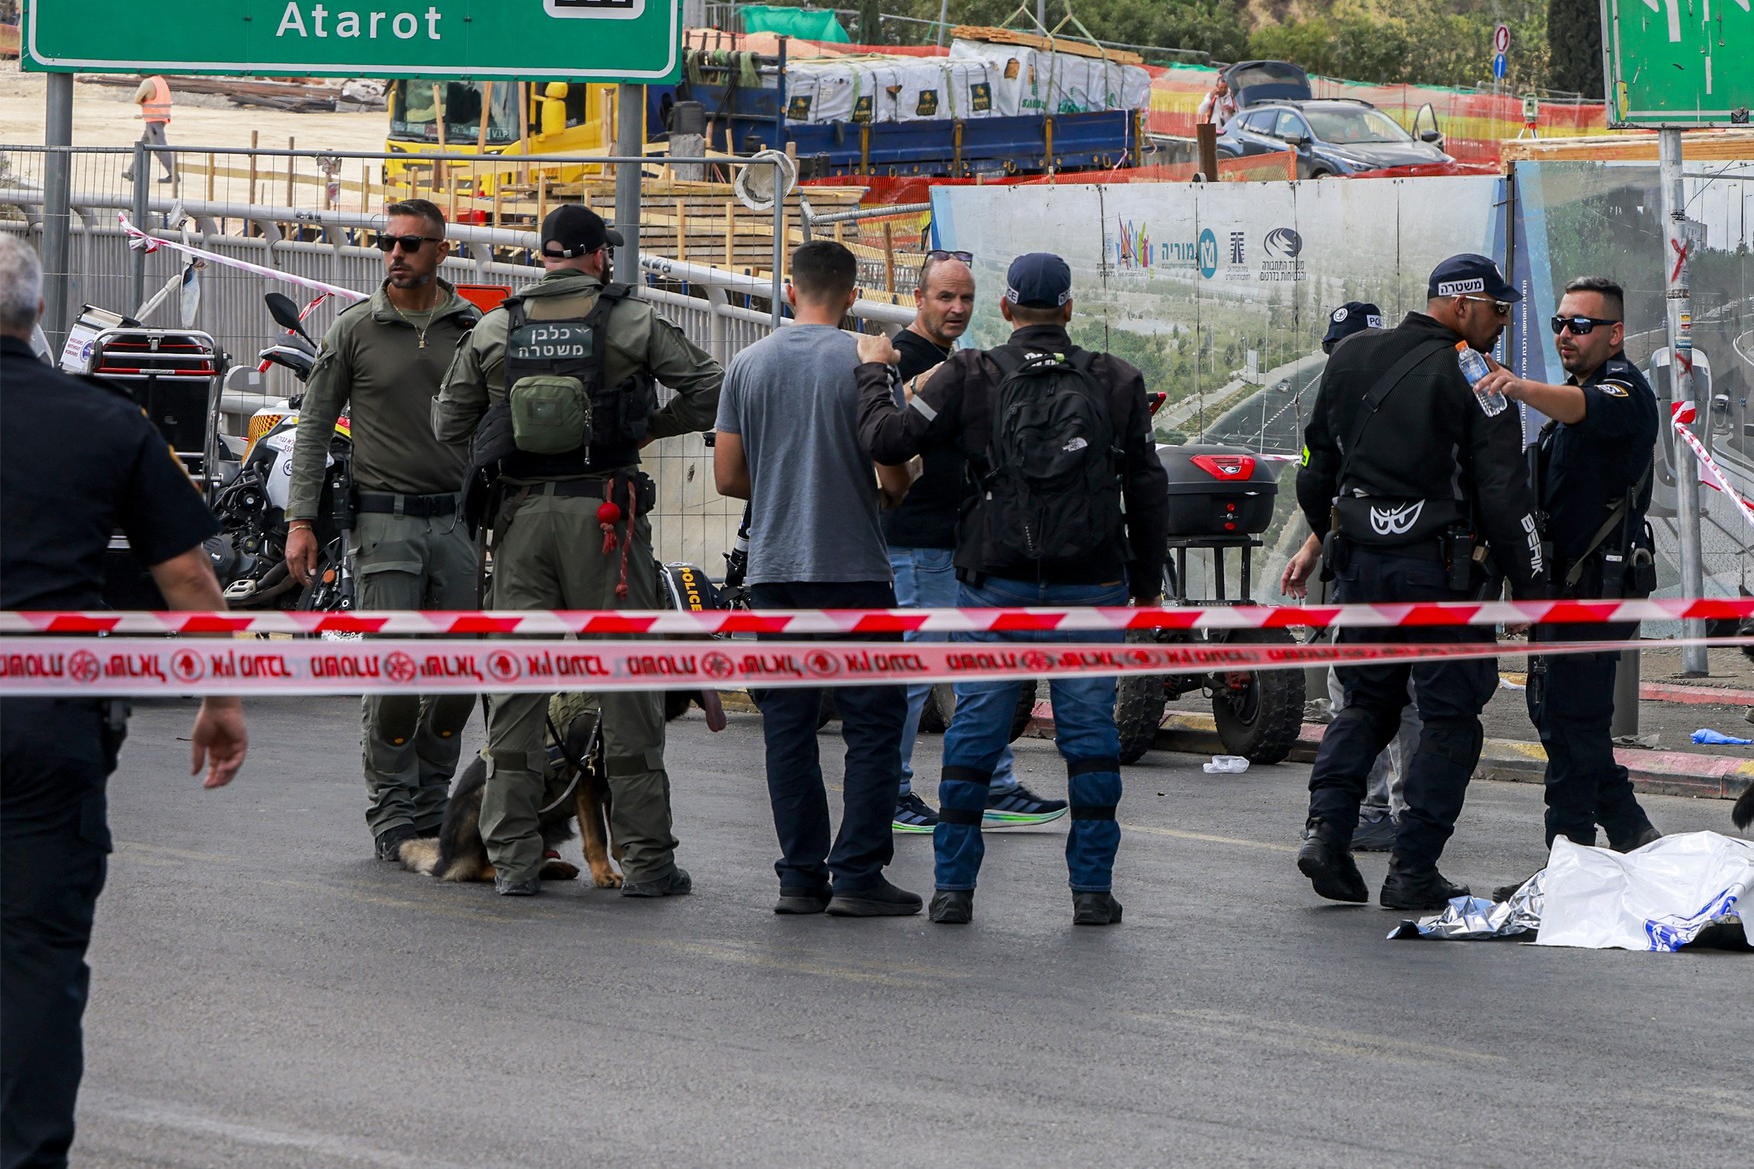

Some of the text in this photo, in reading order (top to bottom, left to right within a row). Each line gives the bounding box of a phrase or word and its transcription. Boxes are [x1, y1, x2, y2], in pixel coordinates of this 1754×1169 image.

[276, 1, 441, 40] Atarot
[1161, 242, 1195, 261] מוריה
[1440, 280, 1482, 294] משטרה
[531, 325, 571, 344] כלבן
[518, 344, 584, 357] משטרה
[678, 567, 703, 612] POLICE
[211, 649, 235, 679] אין
[310, 655, 380, 679] משטרת
[527, 650, 553, 676] אין
[627, 655, 698, 676] משטרת
[845, 649, 870, 673] אין
